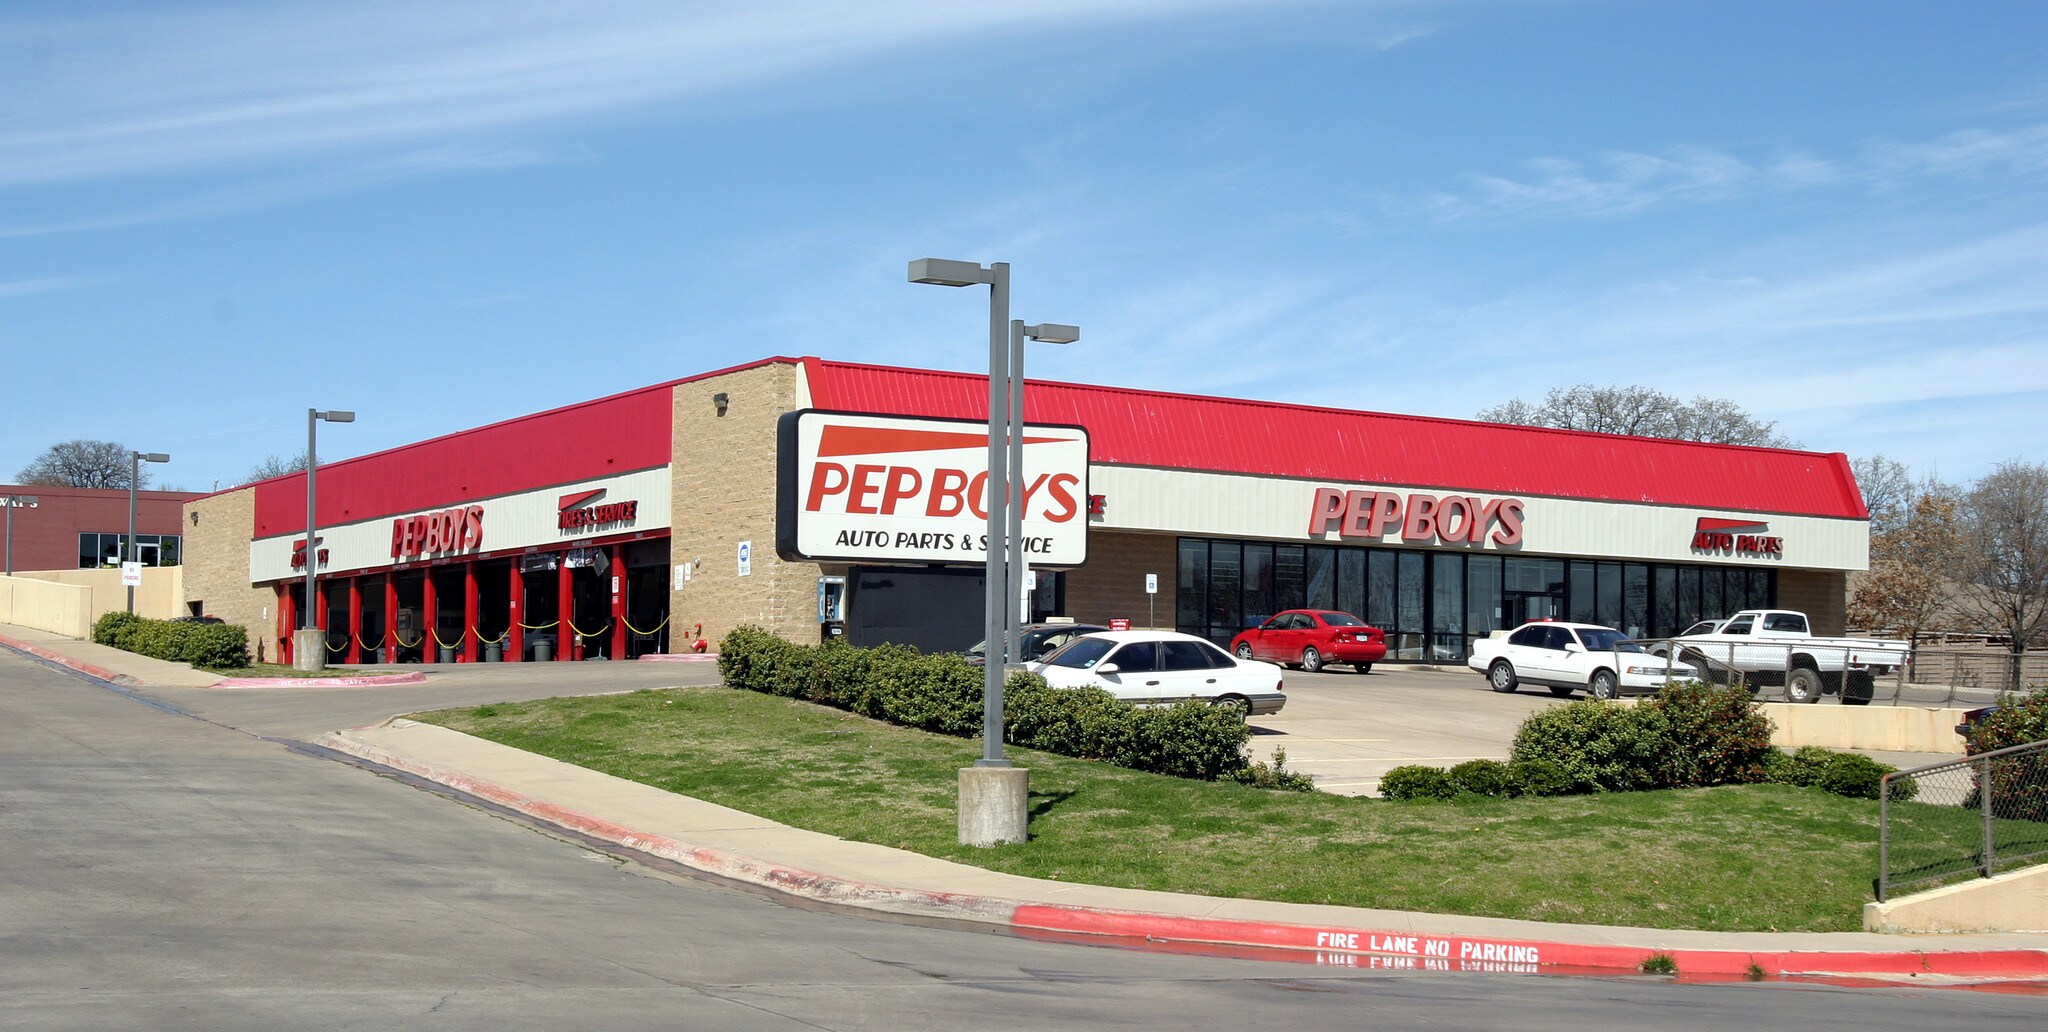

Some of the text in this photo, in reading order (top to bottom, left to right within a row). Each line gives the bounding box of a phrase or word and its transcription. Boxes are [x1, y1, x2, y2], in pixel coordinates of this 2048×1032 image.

[805, 461, 1081, 524] PEP BOYS
[594, 500, 638, 525] SERVICE
[835, 529, 1053, 553] AUTO PARTS & SICE
[1690, 531, 1784, 554] AUTO PARTS
[1317, 931, 1359, 949] FIRE
[1370, 935, 1419, 954] LANE
[1425, 939, 1450, 957] NO
[1460, 941, 1539, 964] PARKING
